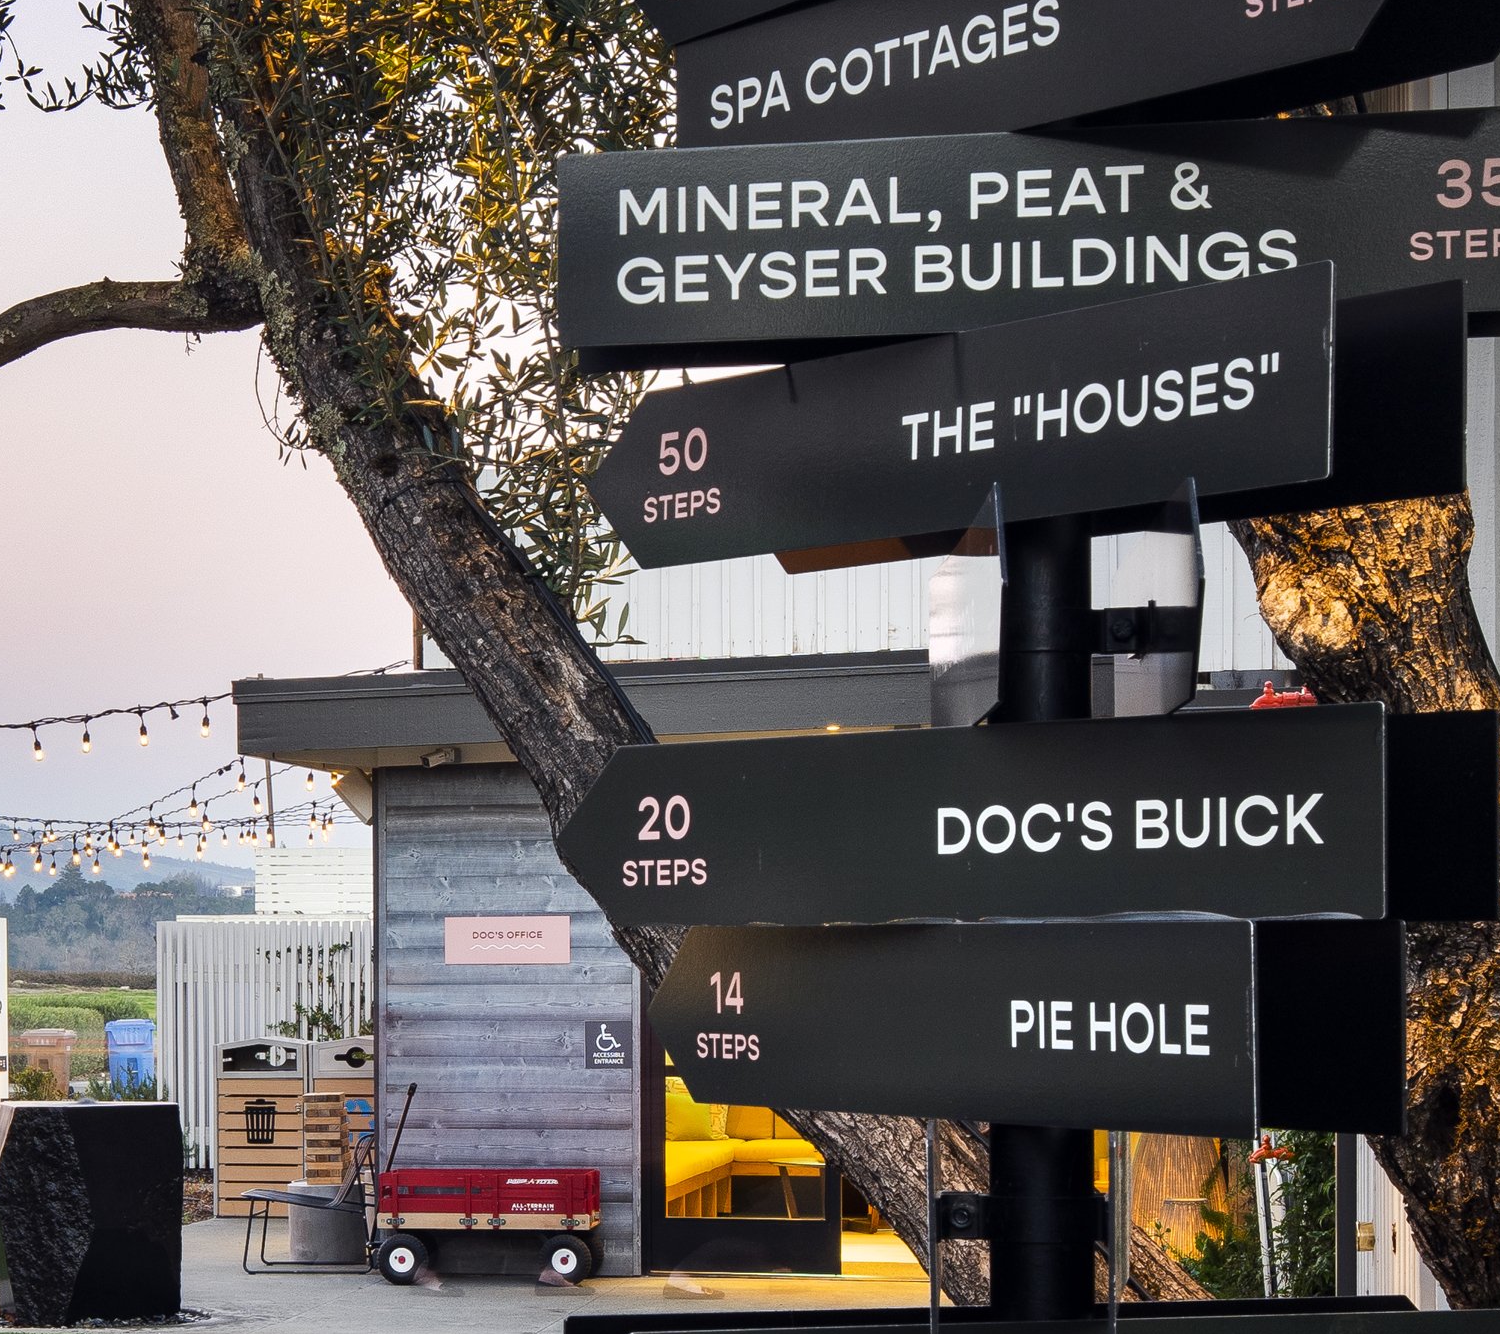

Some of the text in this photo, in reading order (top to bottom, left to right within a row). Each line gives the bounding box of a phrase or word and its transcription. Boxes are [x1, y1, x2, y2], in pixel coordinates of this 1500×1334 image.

[710, 69, 791, 130] SPA
[619, 161, 1213, 236] MINERAL, PEAT &
[617, 229, 1298, 305] GEYSER BUILDINGS
[901, 351, 1280, 461] THE "HOUSES"
[658, 427, 708, 476] 50
[643, 487, 721, 523] STEPS
[638, 794, 691, 841] 20
[937, 793, 1325, 855] DOC'S BUICK
[622, 858, 707, 887] STEPS
[472, 930, 543, 940] DOC'S OFFICE
[710, 971, 744, 1015] 14
[696, 1032, 760, 1061] STEPS
[1010, 999, 1210, 1056] PIE HOLE
